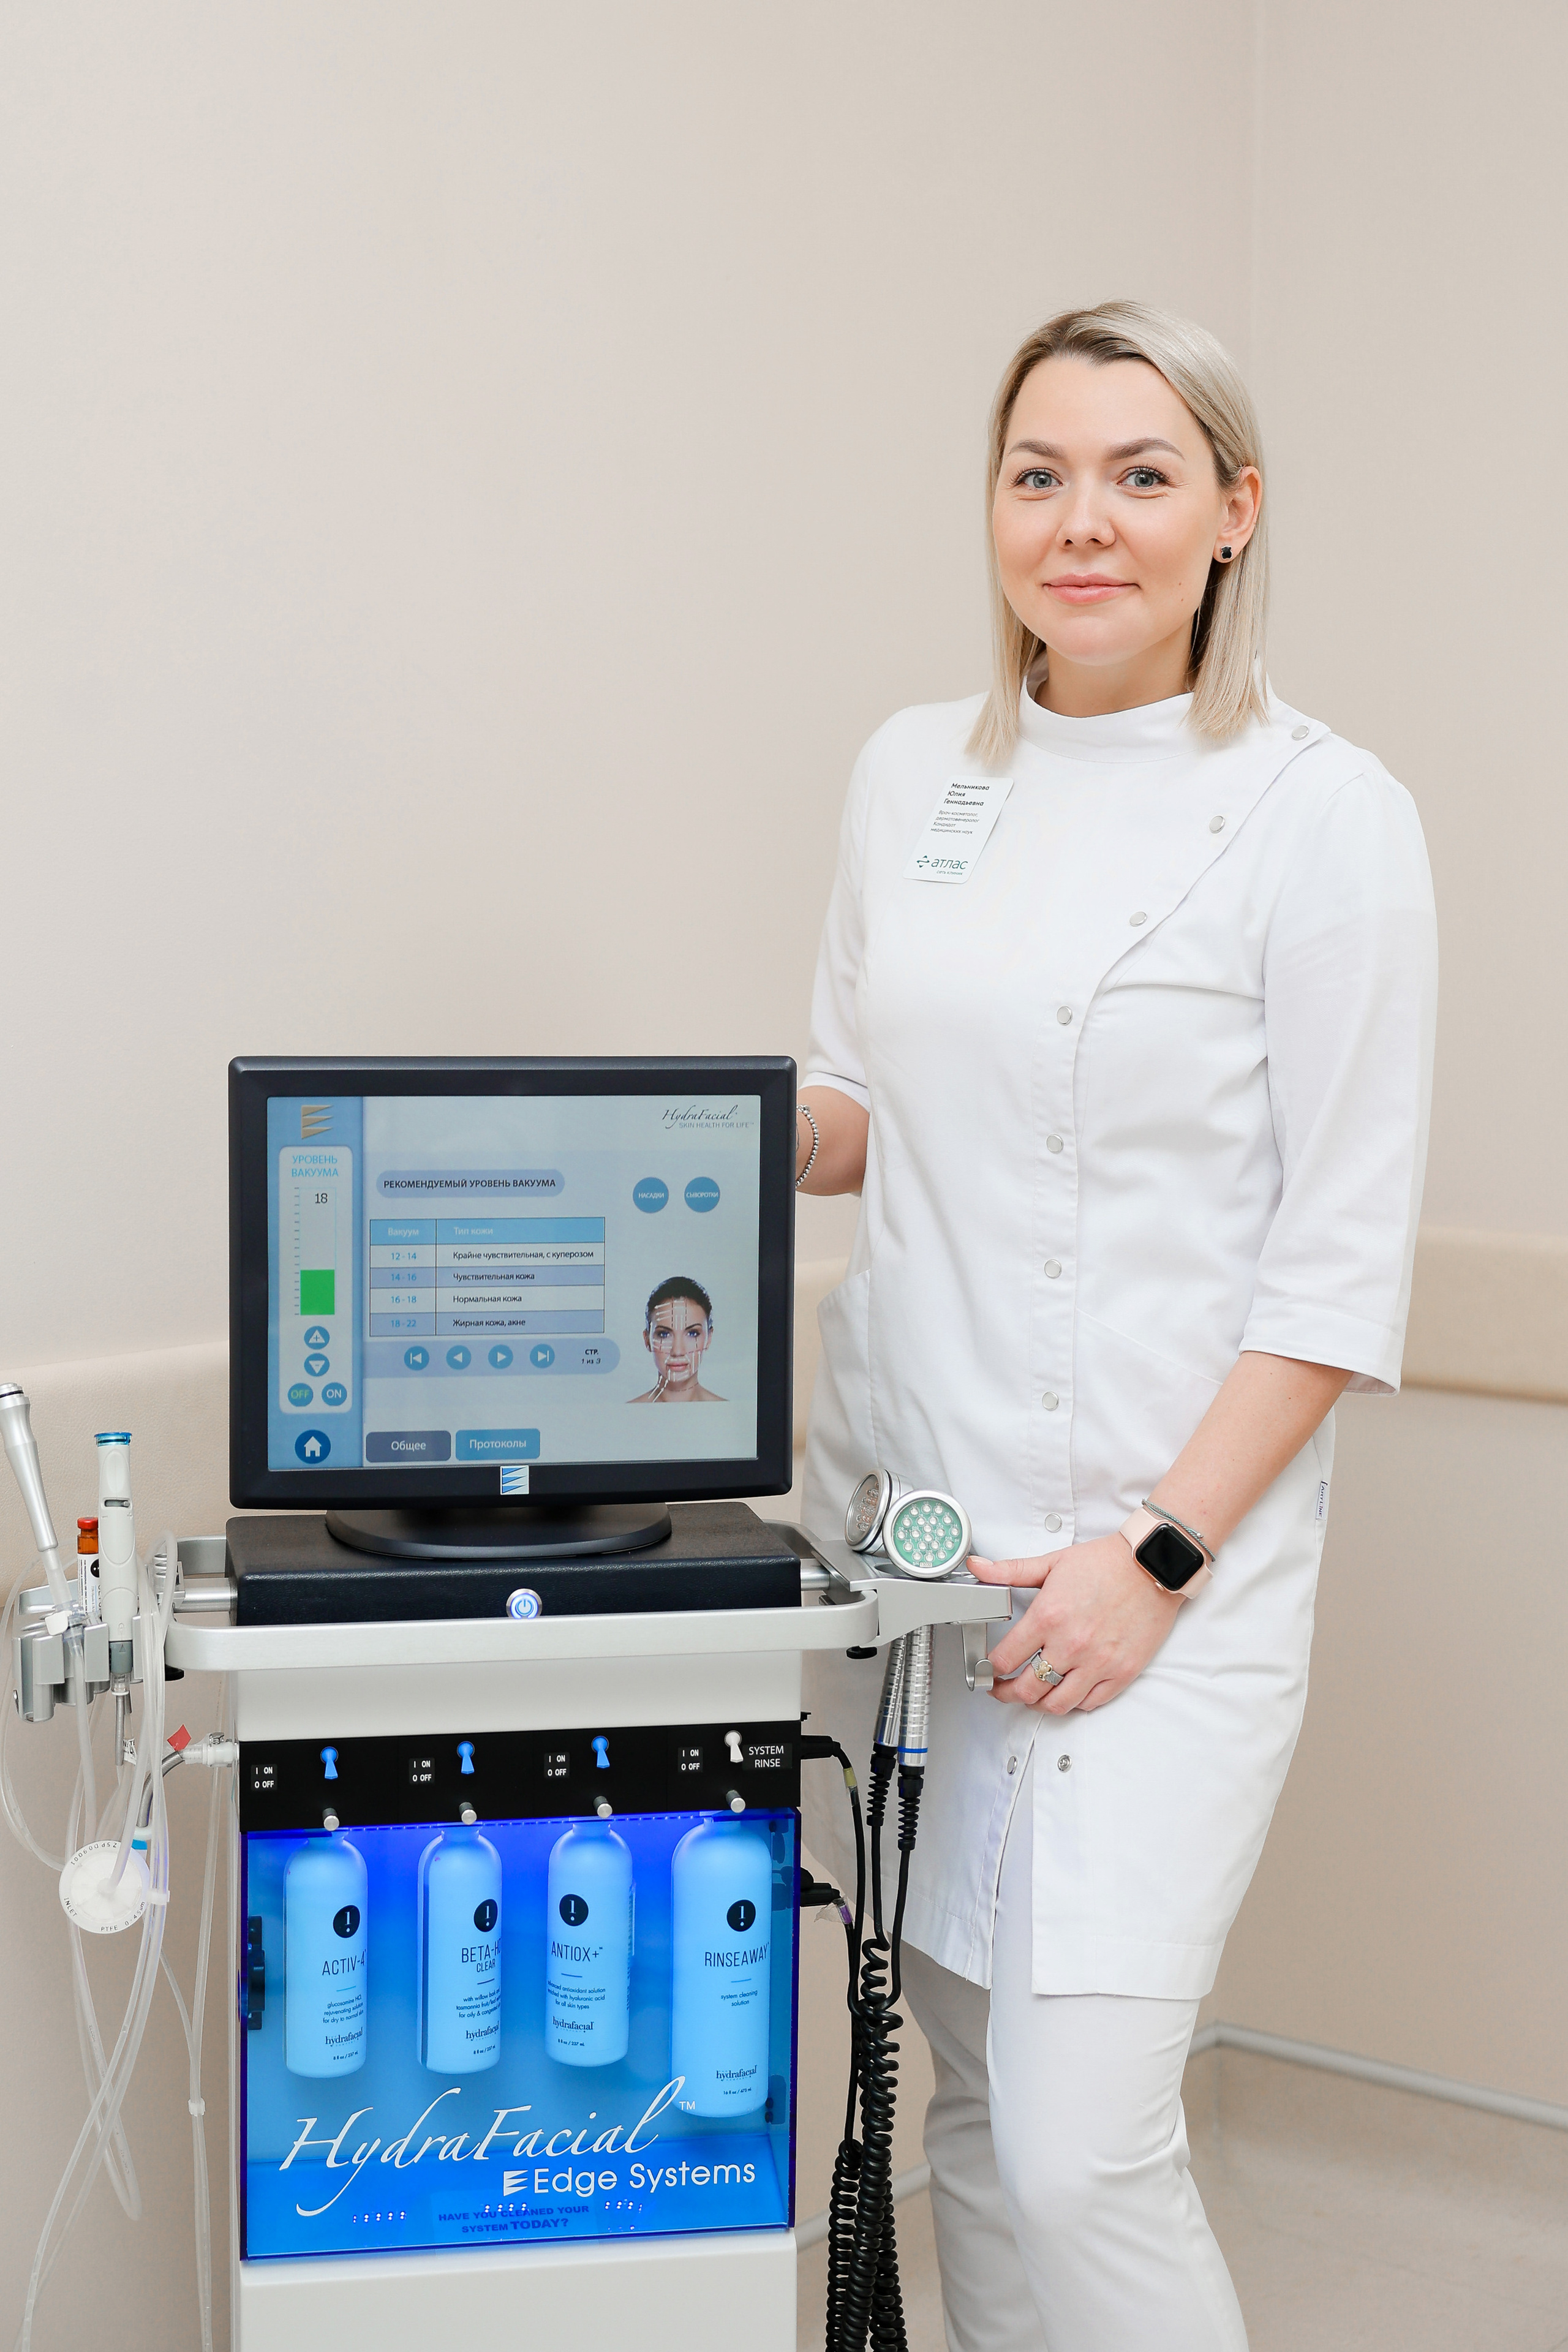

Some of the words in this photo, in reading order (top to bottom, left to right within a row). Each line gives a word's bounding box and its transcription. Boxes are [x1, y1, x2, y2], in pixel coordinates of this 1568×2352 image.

[931, 858, 968, 870] атлас
[662, 1104, 738, 1129] HydraFacial
[292, 1155, 337, 1164] УРОВЕНЬ
[292, 1168, 339, 1178] ВАКУУМА
[383, 1179, 467, 1190] РЕКОМЕНДУЕМЫЙ
[469, 1179, 511, 1188] УРОВЕНЬ
[512, 1179, 556, 1188] ВАКУУМА
[315, 1193, 328, 1204] 18
[388, 1227, 419, 1236] Вакуум
[454, 1227, 469, 1236] Тип
[453, 1251, 481, 1260] Крайне
[483, 1251, 545, 1260] чувствительная,
[552, 1251, 594, 1260] куперозом
[453, 1273, 514, 1281] Чувствительная
[453, 1295, 501, 1304] Нормальная
[453, 1319, 484, 1328] Жирная
[291, 1390, 309, 1399] OFF
[326, 1389, 342, 1399] ON
[391, 1441, 426, 1452] Общее
[469, 1439, 526, 1449] Протоколы
[748, 1745, 784, 1755] SYSTEM
[754, 1758, 781, 1768] RINSE
[64, 1898, 77, 1917] INLET
[705, 1943, 767, 1967] RINSEAWAY
[322, 1951, 365, 1975] ACTIV-4
[477, 1958, 496, 1973] CLEAR
[739, 1990, 758, 1998] cleaning
[327, 1999, 354, 2009] glucosamine
[324, 2007, 351, 2016] rejuvenating
[552, 2016, 594, 2033] hydrafacial
[325, 2026, 363, 2047] hydrafacial
[716, 2065, 757, 2082] hydrafacial
[279, 2076, 685, 2217] HydraFacial
[679, 2101, 696, 2110] TM
[533, 2170, 617, 2198] Edge
[629, 2161, 756, 2193] Systems
[439, 2212, 469, 2221] HAVE
[473, 2211, 497, 2220] YOU
[500, 2207, 553, 2218] CLEANED
[557, 2206, 590, 2214] YOUR
[462, 2223, 508, 2233] SYSTEM
[510, 2218, 569, 2230] TODAY?
